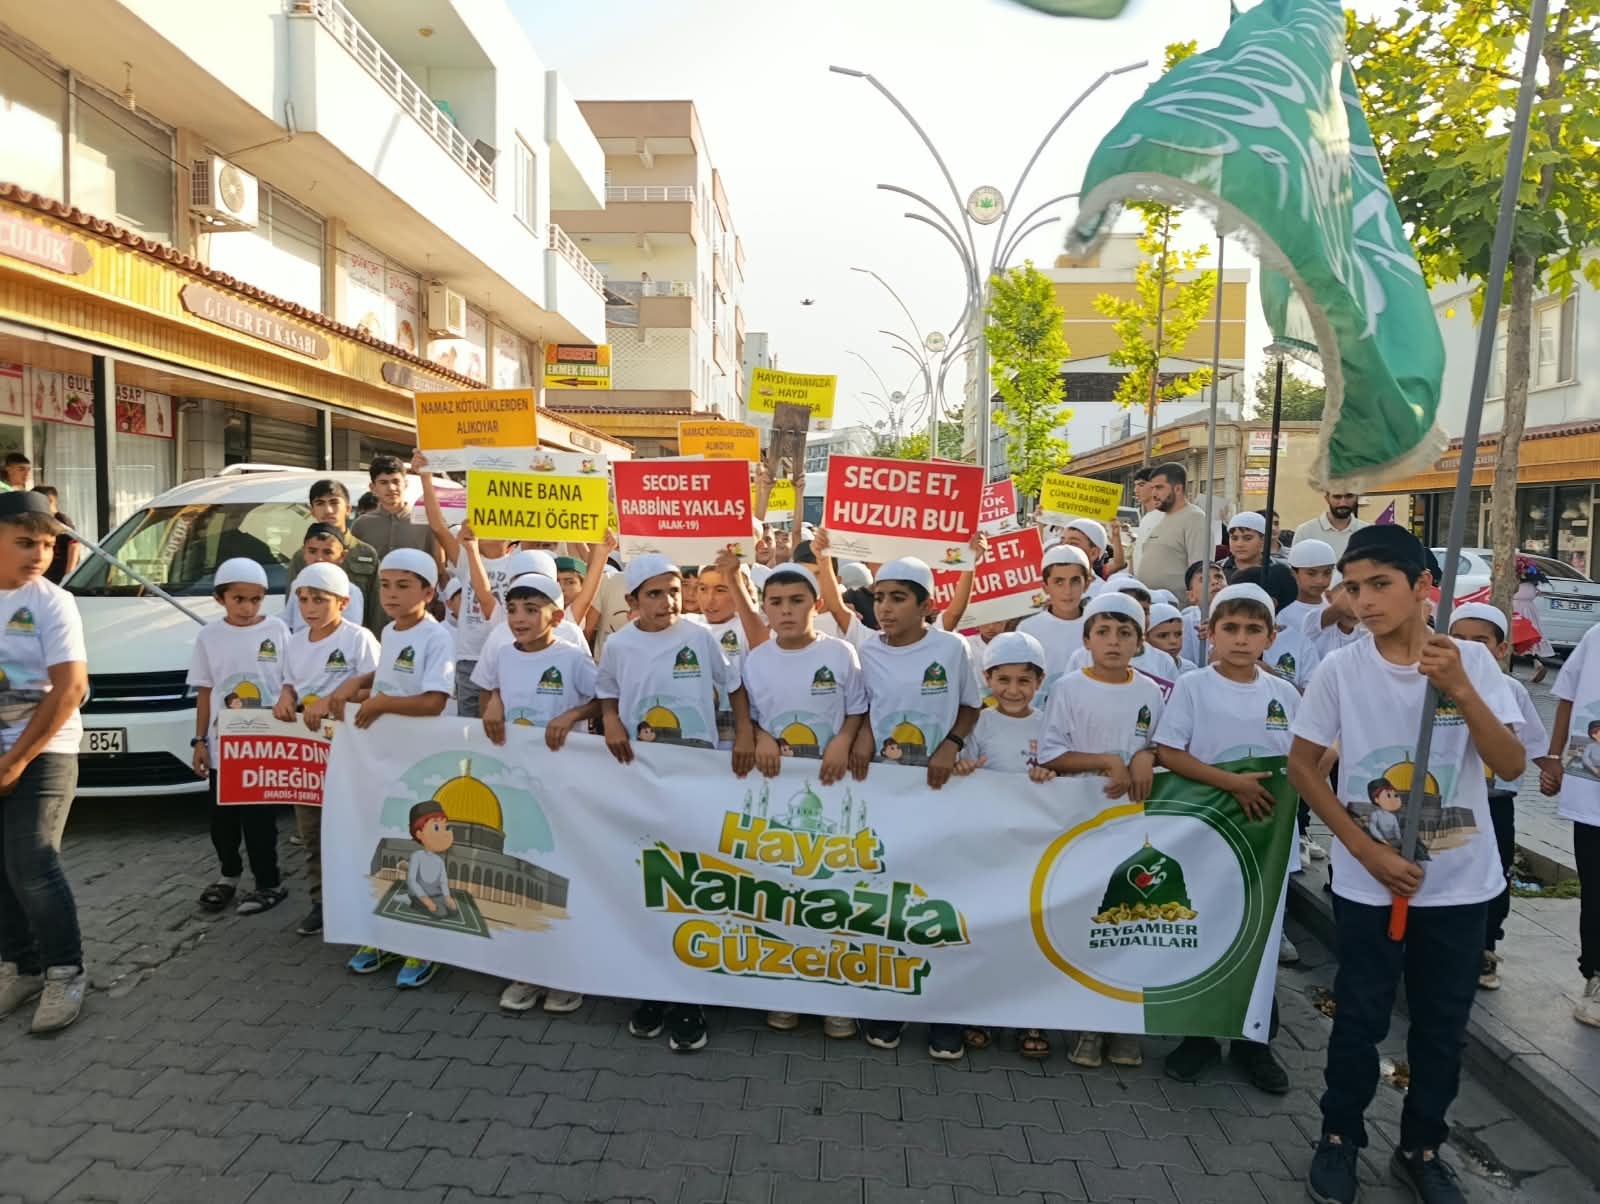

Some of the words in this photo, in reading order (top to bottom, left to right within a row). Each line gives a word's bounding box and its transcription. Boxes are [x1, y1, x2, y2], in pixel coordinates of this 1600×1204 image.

[256, 318, 273, 338] ET
[115, 385, 142, 401] ASAP
[421, 401, 454, 414] NAMAZ
[456, 419, 499, 435] ALIKOYAR
[487, 479, 533, 499] ANNE
[538, 482, 582, 502] BANA
[642, 474, 690, 491] SECDE
[691, 474, 711, 491] ET
[844, 465, 924, 494] SECDE
[927, 472, 959, 501] ET,
[1046, 477, 1076, 489] NAMAZ
[1076, 481, 1119, 497] KILIYORUM
[474, 507, 541, 528] NAMAZI
[545, 507, 599, 531] ÖĞRET
[621, 496, 680, 516] RABBİNE
[684, 499, 745, 520] YAKLAŞ
[833, 500, 917, 530] HUZUR
[920, 508, 969, 535] BUL
[658, 519, 700, 531] (ALAK-19)
[997, 538, 1025, 560] ET,
[935, 572, 1003, 604] HUR
[1004, 564, 1043, 588] BUL
[89, 732, 120, 751] 854
[223, 740, 299, 761] NAMAZ
[302, 741, 329, 764] DİN
[241, 765, 326, 791] DİREĞİDİ
[718, 810, 886, 880] Hayat
[641, 847, 971, 948] Namazla
[1089, 922, 1198, 938] PEYGAMBER
[1088, 937, 1198, 949] SEVDALILARI
[672, 918, 932, 996] Güzeldir
